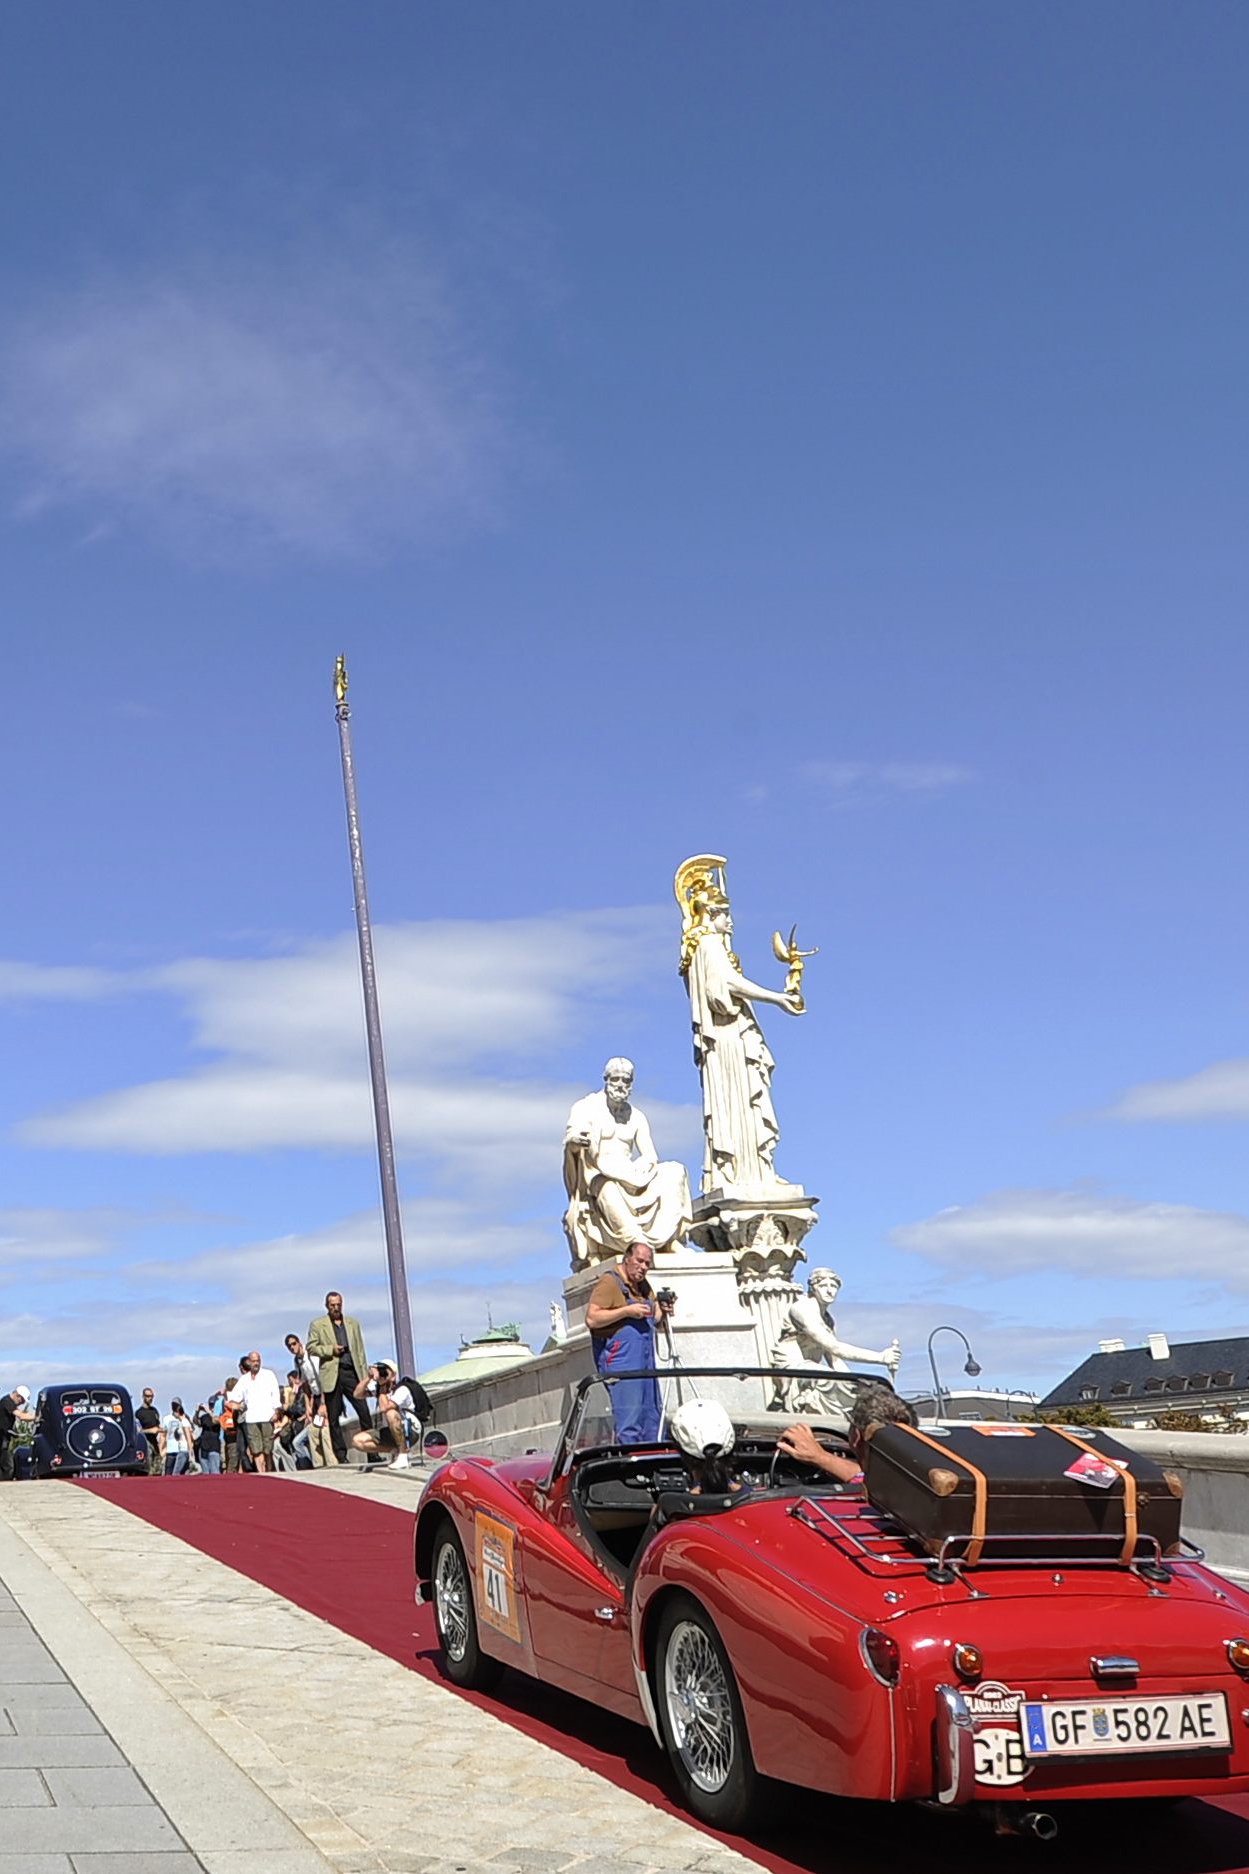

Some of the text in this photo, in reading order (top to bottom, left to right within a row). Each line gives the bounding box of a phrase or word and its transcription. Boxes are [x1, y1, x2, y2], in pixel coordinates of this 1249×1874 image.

[487, 1568, 502, 1613] 41
[1033, 1734, 1042, 1746] A
[1051, 1703, 1216, 1745] GF 582 AE
[973, 1738, 1028, 1776] GB
